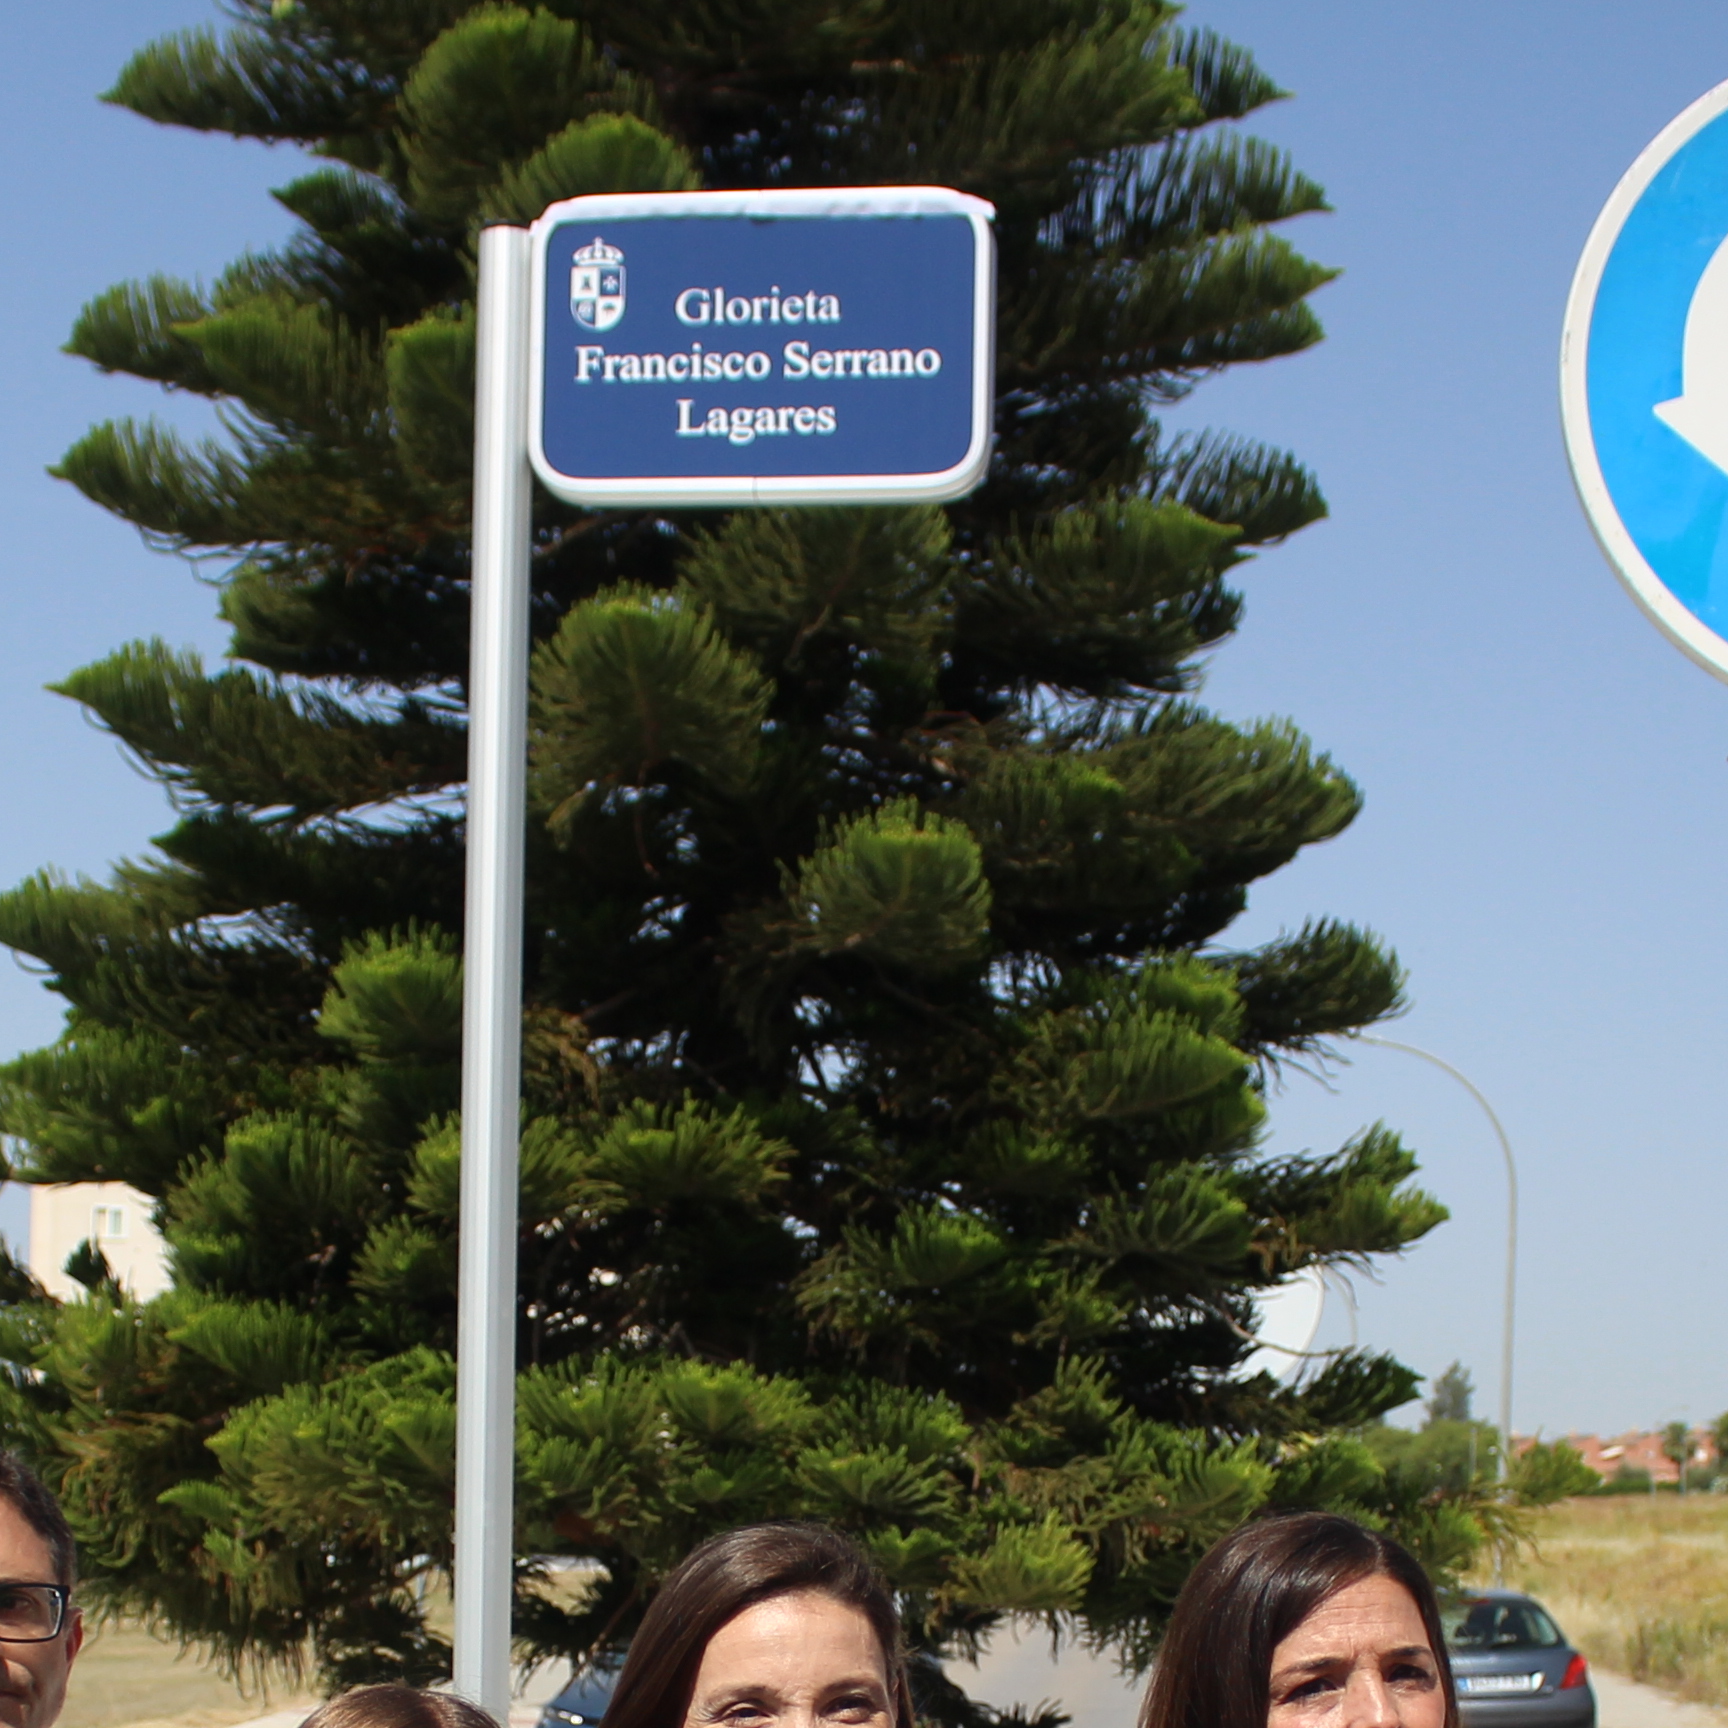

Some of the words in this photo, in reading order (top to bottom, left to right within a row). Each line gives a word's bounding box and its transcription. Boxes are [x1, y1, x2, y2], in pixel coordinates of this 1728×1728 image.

[675, 287, 841, 325] Glorieta
[575, 343, 772, 382] Francisco
[783, 341, 941, 379] Serrano
[676, 399, 837, 445] Lagares
